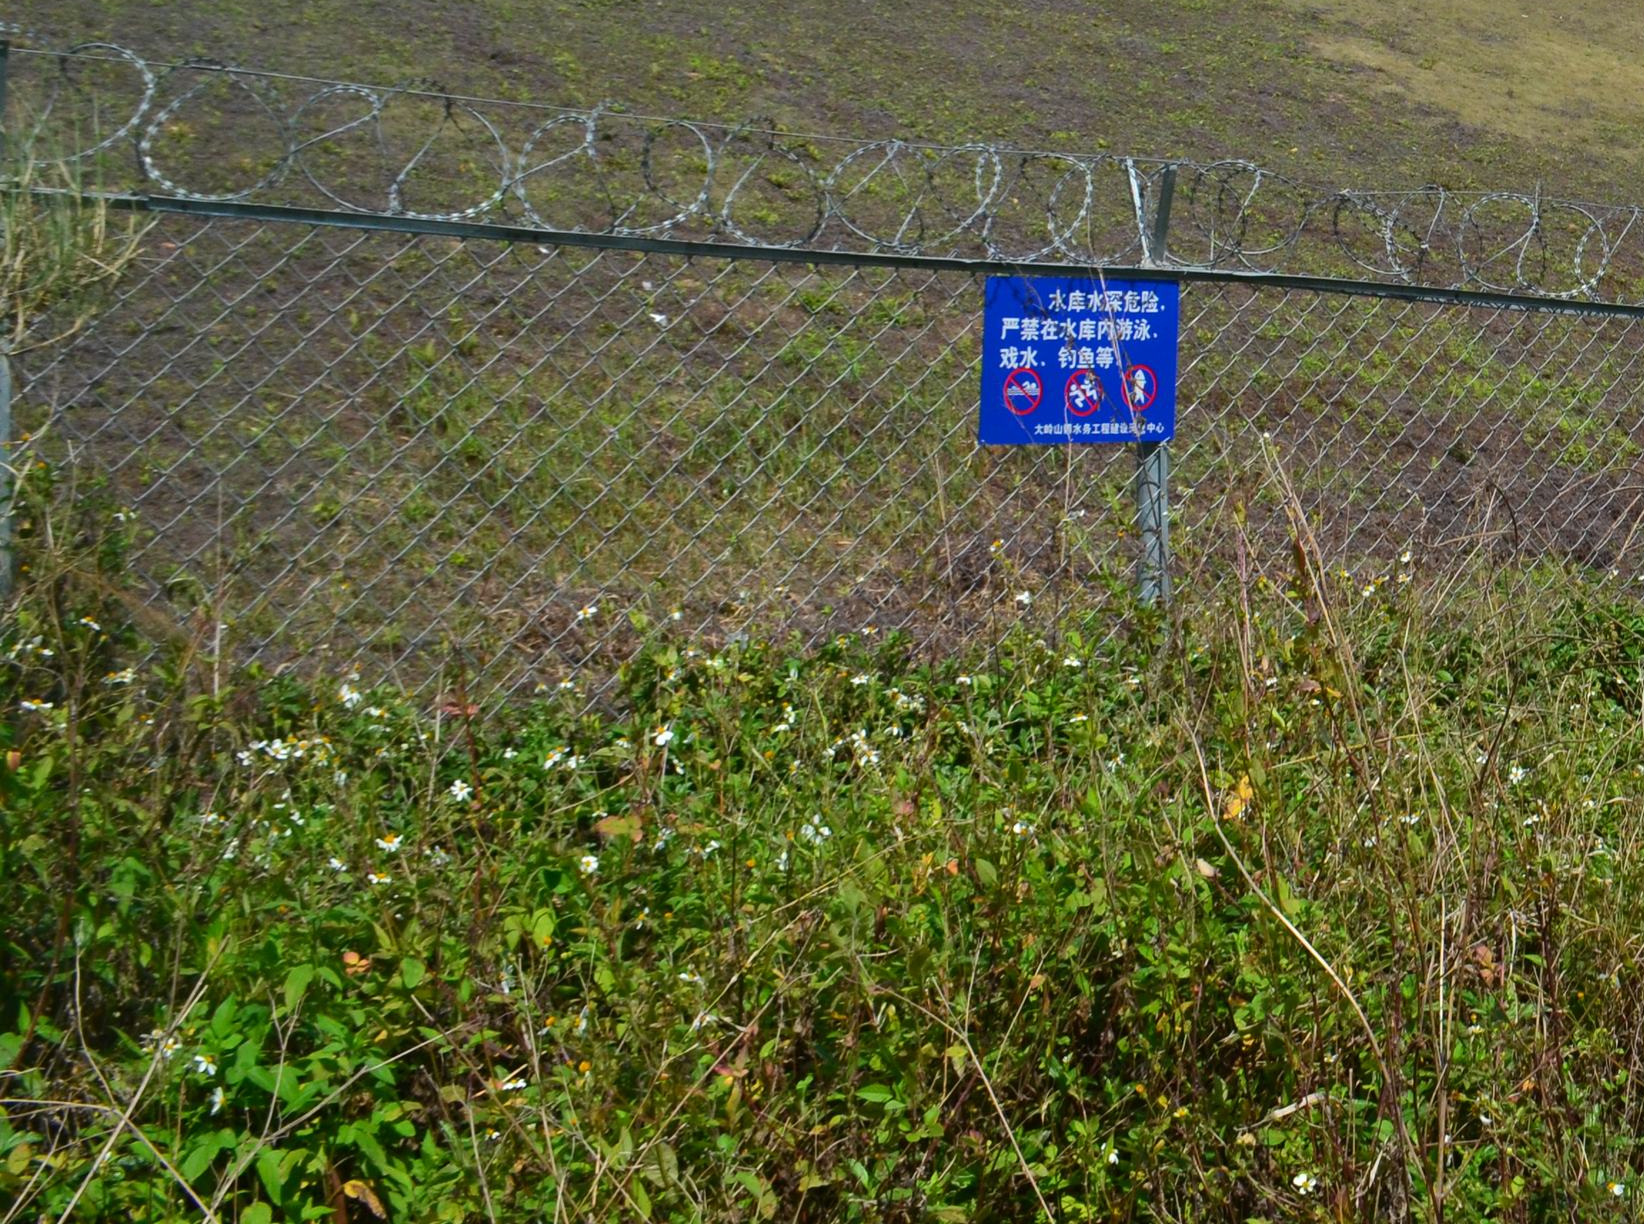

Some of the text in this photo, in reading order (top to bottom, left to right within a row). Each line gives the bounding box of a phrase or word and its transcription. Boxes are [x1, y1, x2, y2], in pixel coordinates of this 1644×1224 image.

[1034, 422, 1165, 435] 大岭山镇水务工程建设中心
